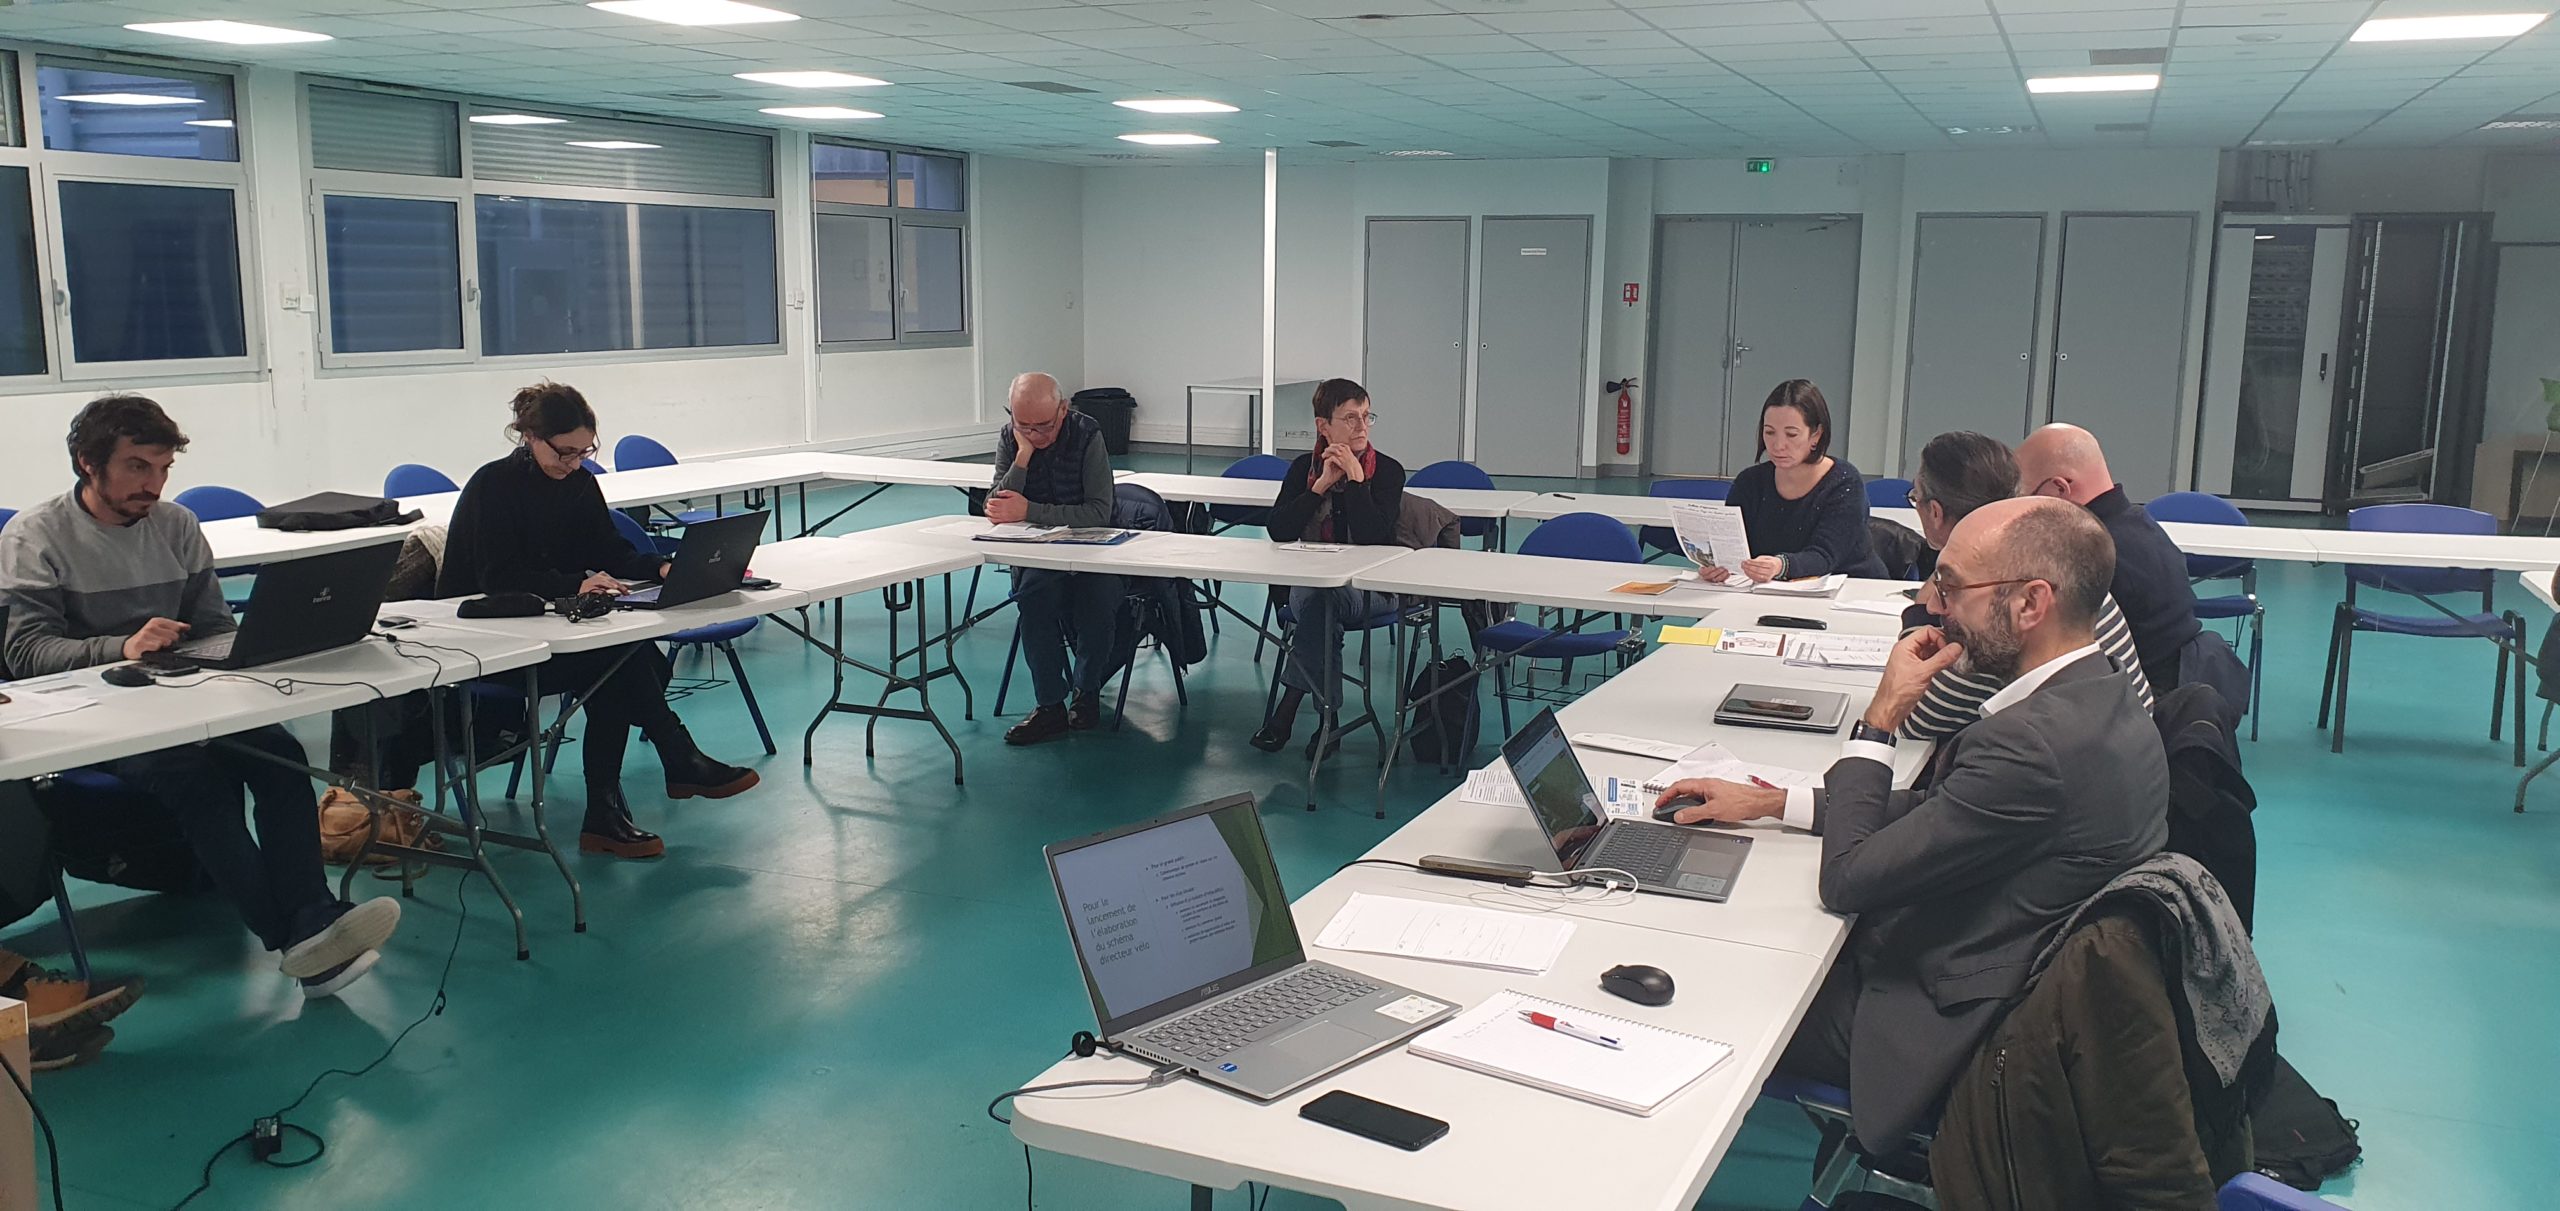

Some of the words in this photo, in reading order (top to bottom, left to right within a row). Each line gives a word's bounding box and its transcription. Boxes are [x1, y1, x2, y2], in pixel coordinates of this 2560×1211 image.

[1082, 900, 1100, 912] Pour
[1101, 898, 1109, 906] le
[1086, 906, 1126, 925] lancement
[1126, 903, 1137, 913] de
[1095, 941, 1106, 952] du
[1099, 947, 1133, 965] directeur
